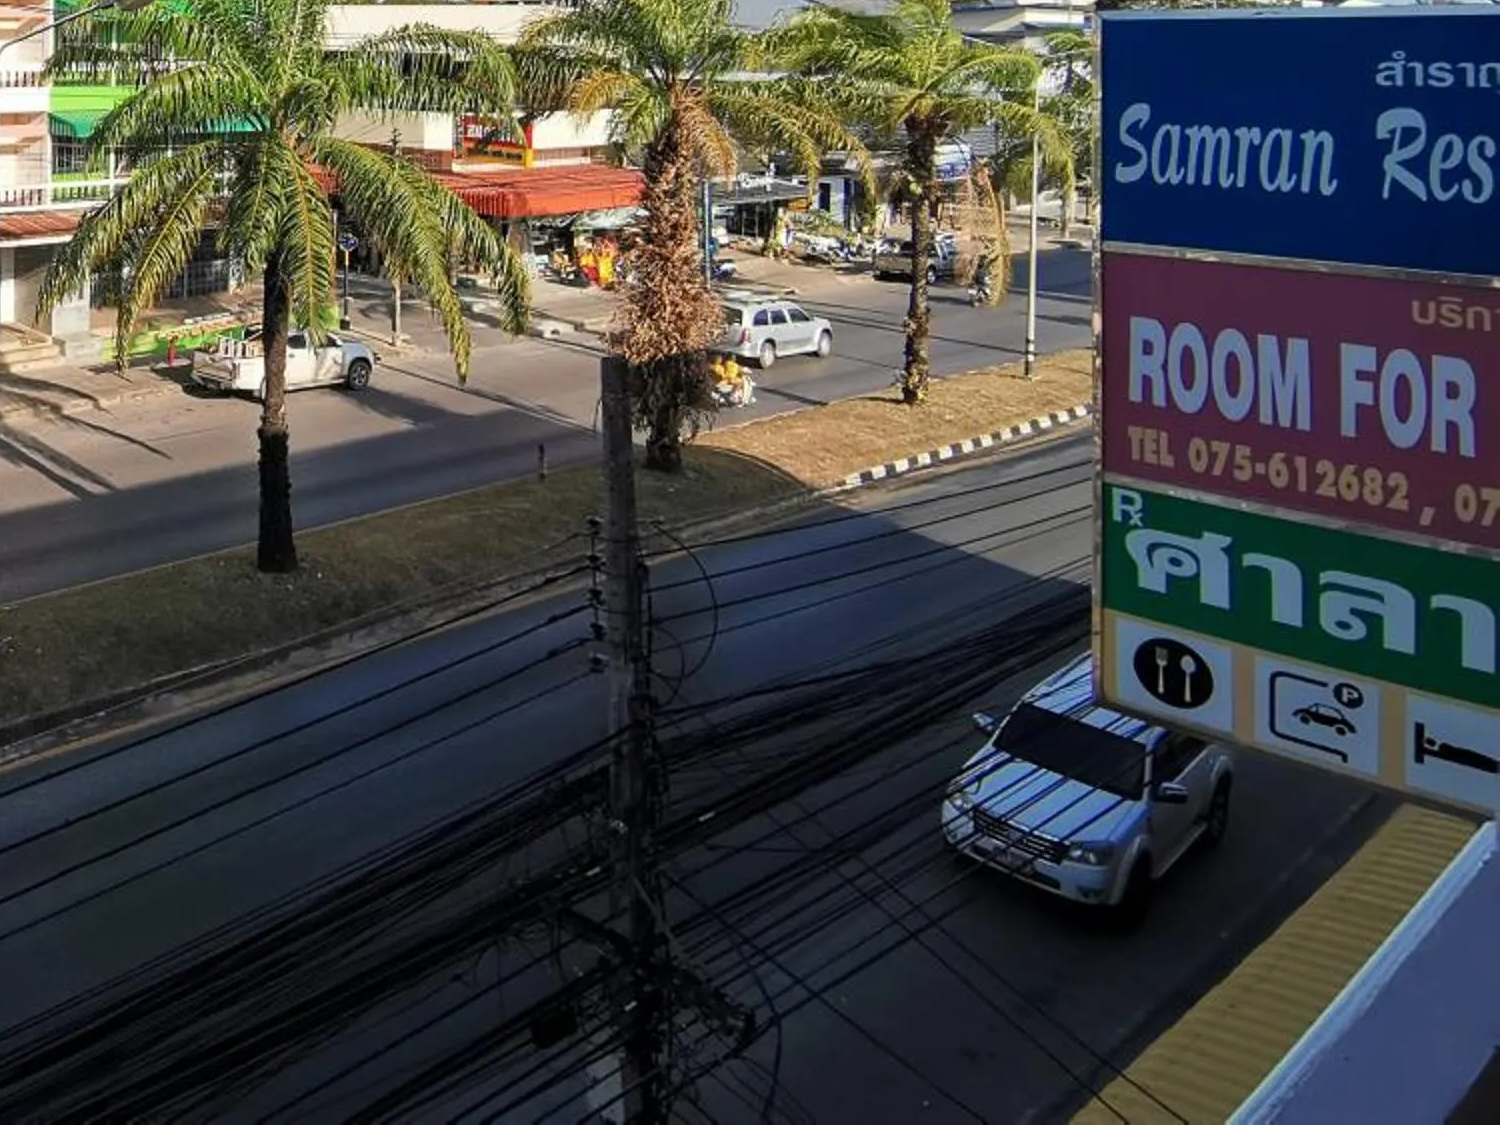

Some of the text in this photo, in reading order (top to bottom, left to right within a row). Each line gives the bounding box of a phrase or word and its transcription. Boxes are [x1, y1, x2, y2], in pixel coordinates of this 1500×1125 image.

[1115, 102, 1496, 204] Samran Res
[1411, 296, 1500, 332] บริก
[1128, 316, 1476, 457] ROOM FOR
[1128, 426, 1175, 468] TEL
[1188, 437, 1410, 512] 075-612682
[1454, 483, 1500, 527] 07
[1125, 528, 1496, 675] ศาลา
